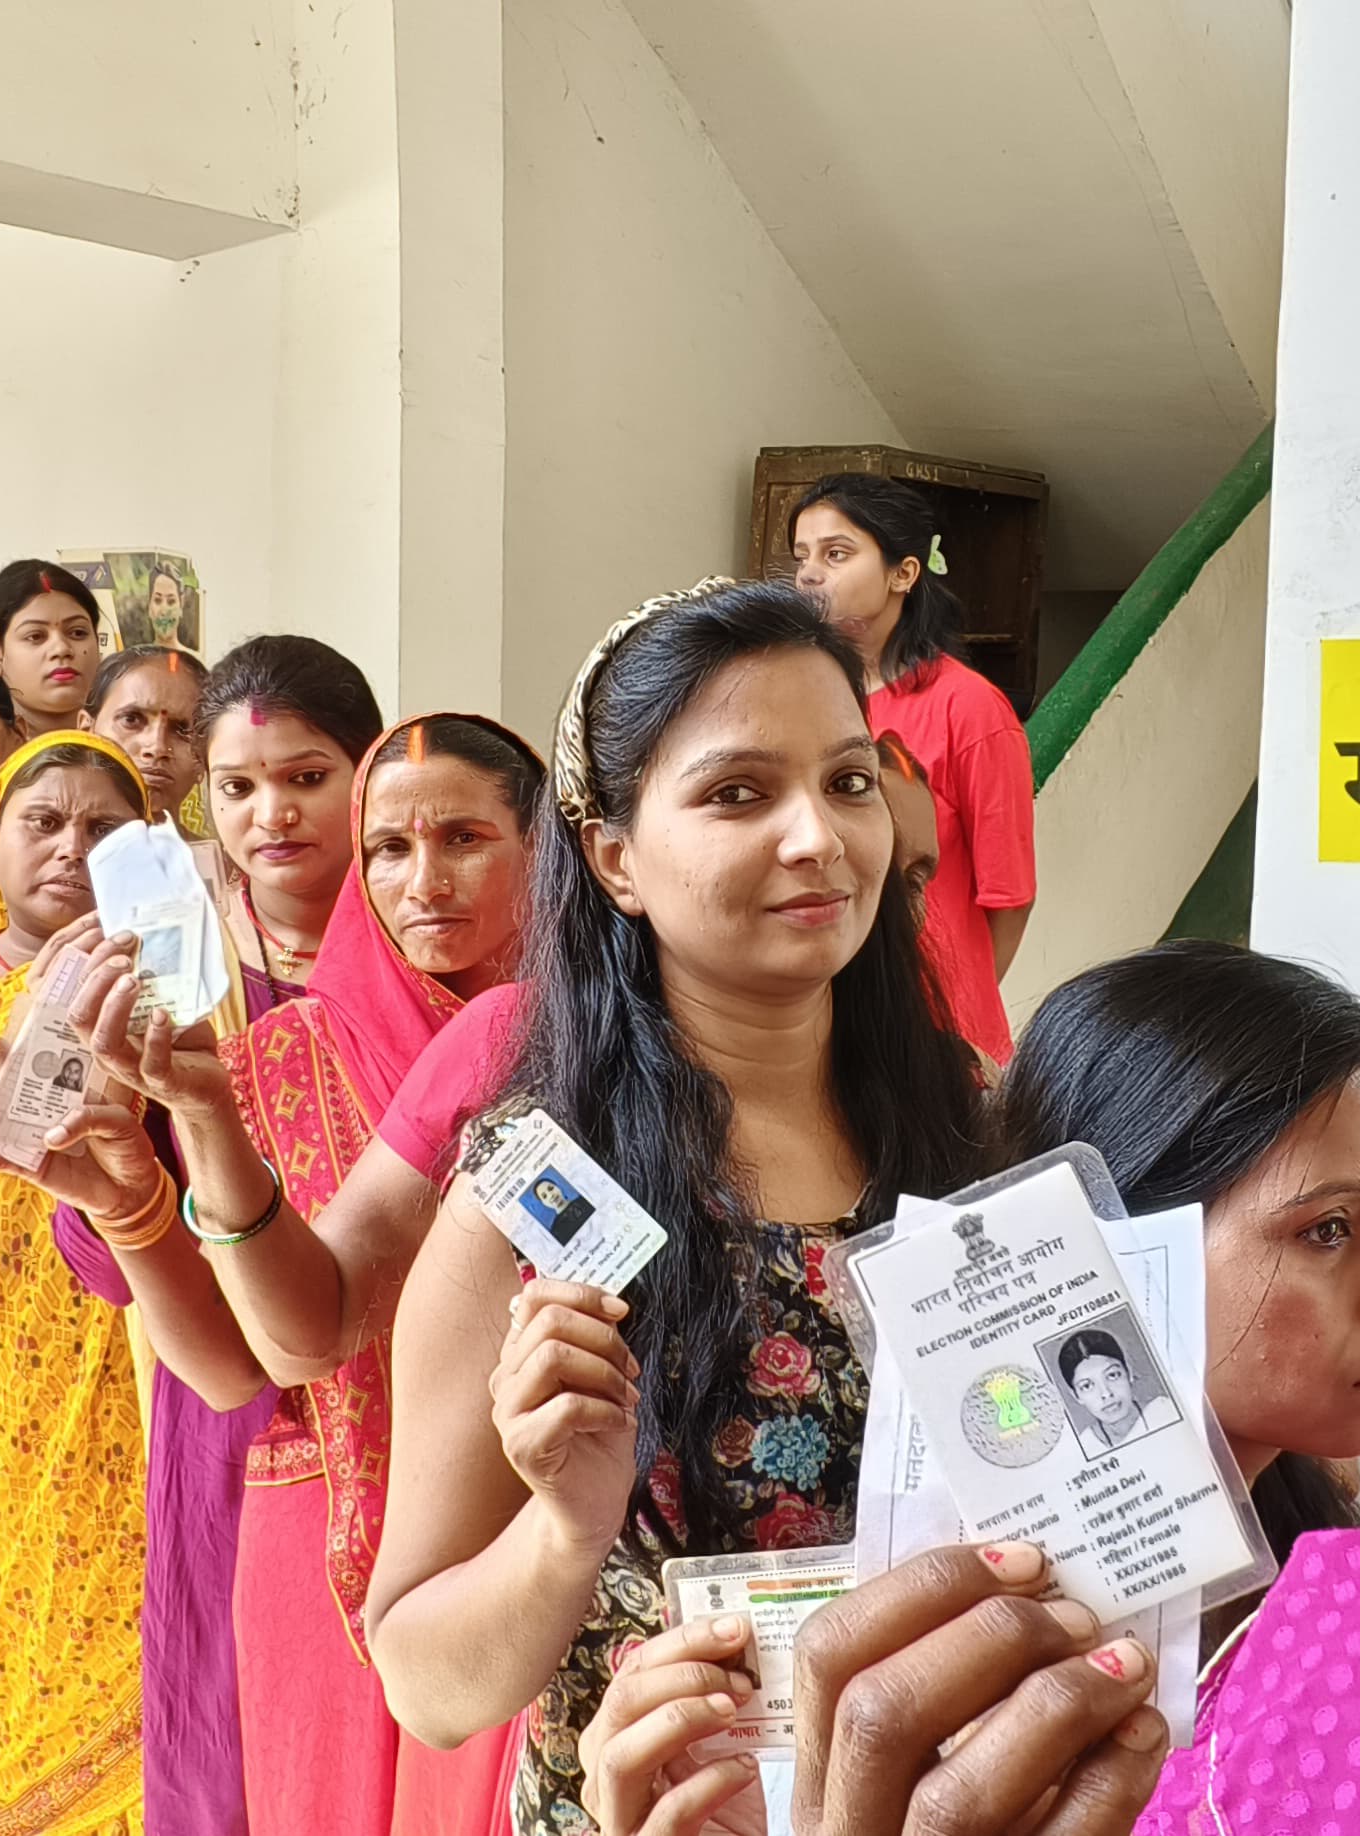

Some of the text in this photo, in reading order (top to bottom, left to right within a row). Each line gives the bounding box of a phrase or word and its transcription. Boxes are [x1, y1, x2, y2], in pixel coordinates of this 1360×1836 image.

[911, 1236, 1066, 1315] भारत निर्वाचन आयोग
[958, 1270, 1038, 1316] परिचय पत्र
[916, 1269, 1099, 1358] ELECTION COMMISSION OF INDIA
[969, 1305, 1057, 1350] IDENTITY CARD
[1080, 1484, 1119, 1509] Munita
[1120, 1469, 1147, 1490] Devi
[1055, 1482, 1219, 1564] Name Rajesh Kumar Sharma
[1139, 1523, 1181, 1549] Female
